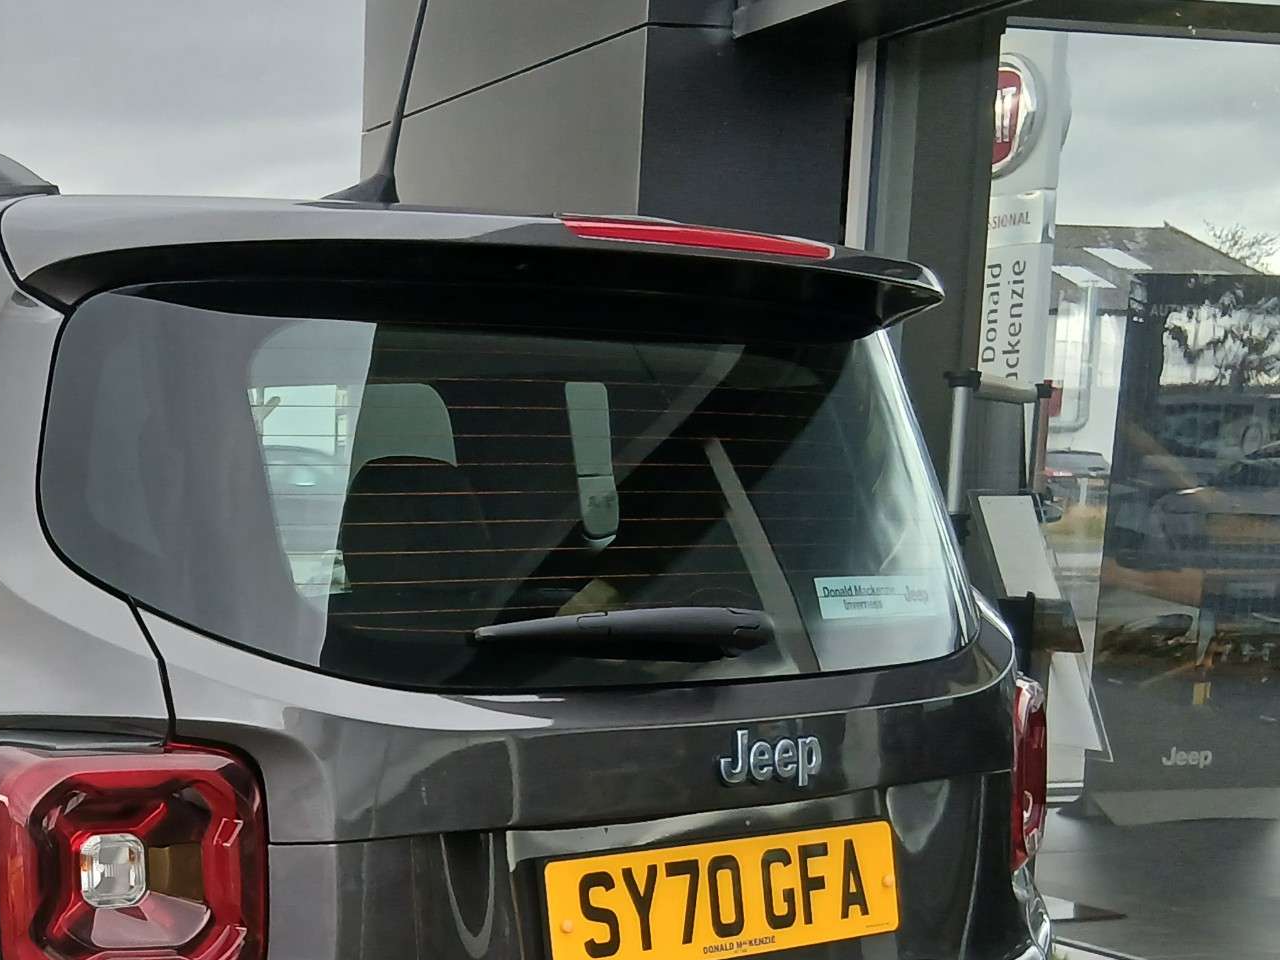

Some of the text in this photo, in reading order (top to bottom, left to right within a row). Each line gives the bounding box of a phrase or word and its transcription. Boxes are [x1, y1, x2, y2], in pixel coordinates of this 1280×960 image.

[981, 262, 1003, 364] Donald
[822, 585, 853, 598] Donald
[719, 728, 823, 787] Jeep
[1161, 746, 1213, 769] Jeep
[578, 837, 871, 960] SY70 GFA
[702, 941, 735, 955] DONALD
